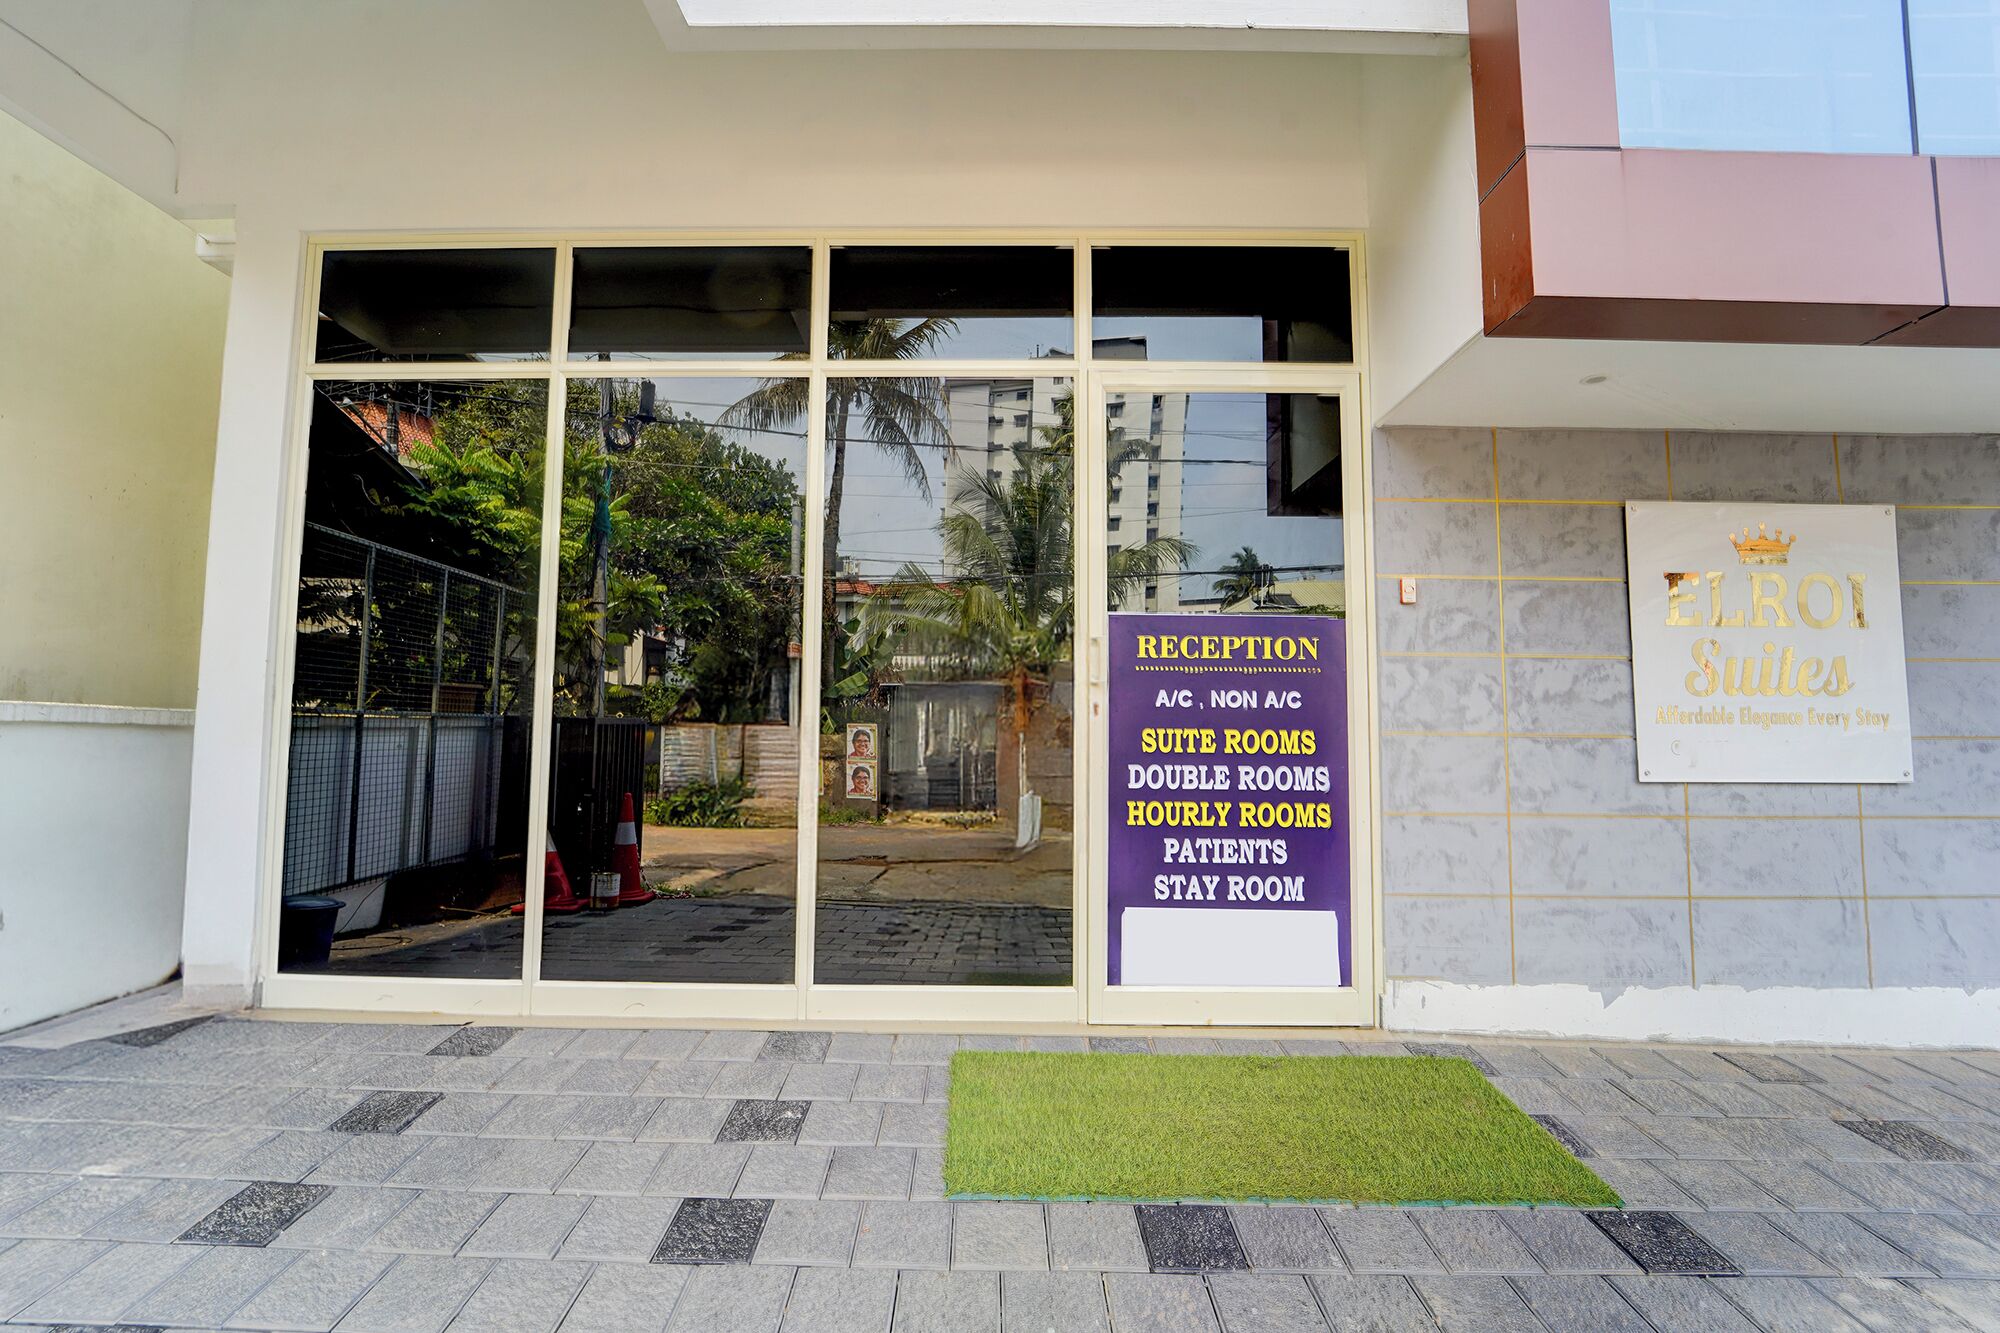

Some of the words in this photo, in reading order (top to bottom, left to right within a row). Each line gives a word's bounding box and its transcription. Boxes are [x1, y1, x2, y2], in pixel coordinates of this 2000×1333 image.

[1663, 571, 1869, 629] ELROI
[1136, 635, 1319, 660] RECEPTION
[1685, 637, 1855, 697] Suites
[1155, 690, 1193, 708] A/C
[1211, 690, 1258, 709] NON
[1264, 691, 1302, 708] A/C
[1655, 706, 1734, 725] Affordable
[1739, 707, 1802, 730] Elegance
[1808, 708, 1850, 730] Every
[1856, 707, 1890, 730] Stay
[1142, 728, 1216, 753] SUITE
[1224, 729, 1316, 755] ROOMS
[1128, 764, 1230, 790] DOUBLE
[1238, 766, 1330, 792] ROOMS
[1127, 801, 1232, 827] HOURLY
[1239, 802, 1332, 828] ROOMS
[1163, 838, 1287, 864] PATIENTS
[1154, 874, 1220, 901] STAY
[1227, 876, 1305, 901] ROOM
